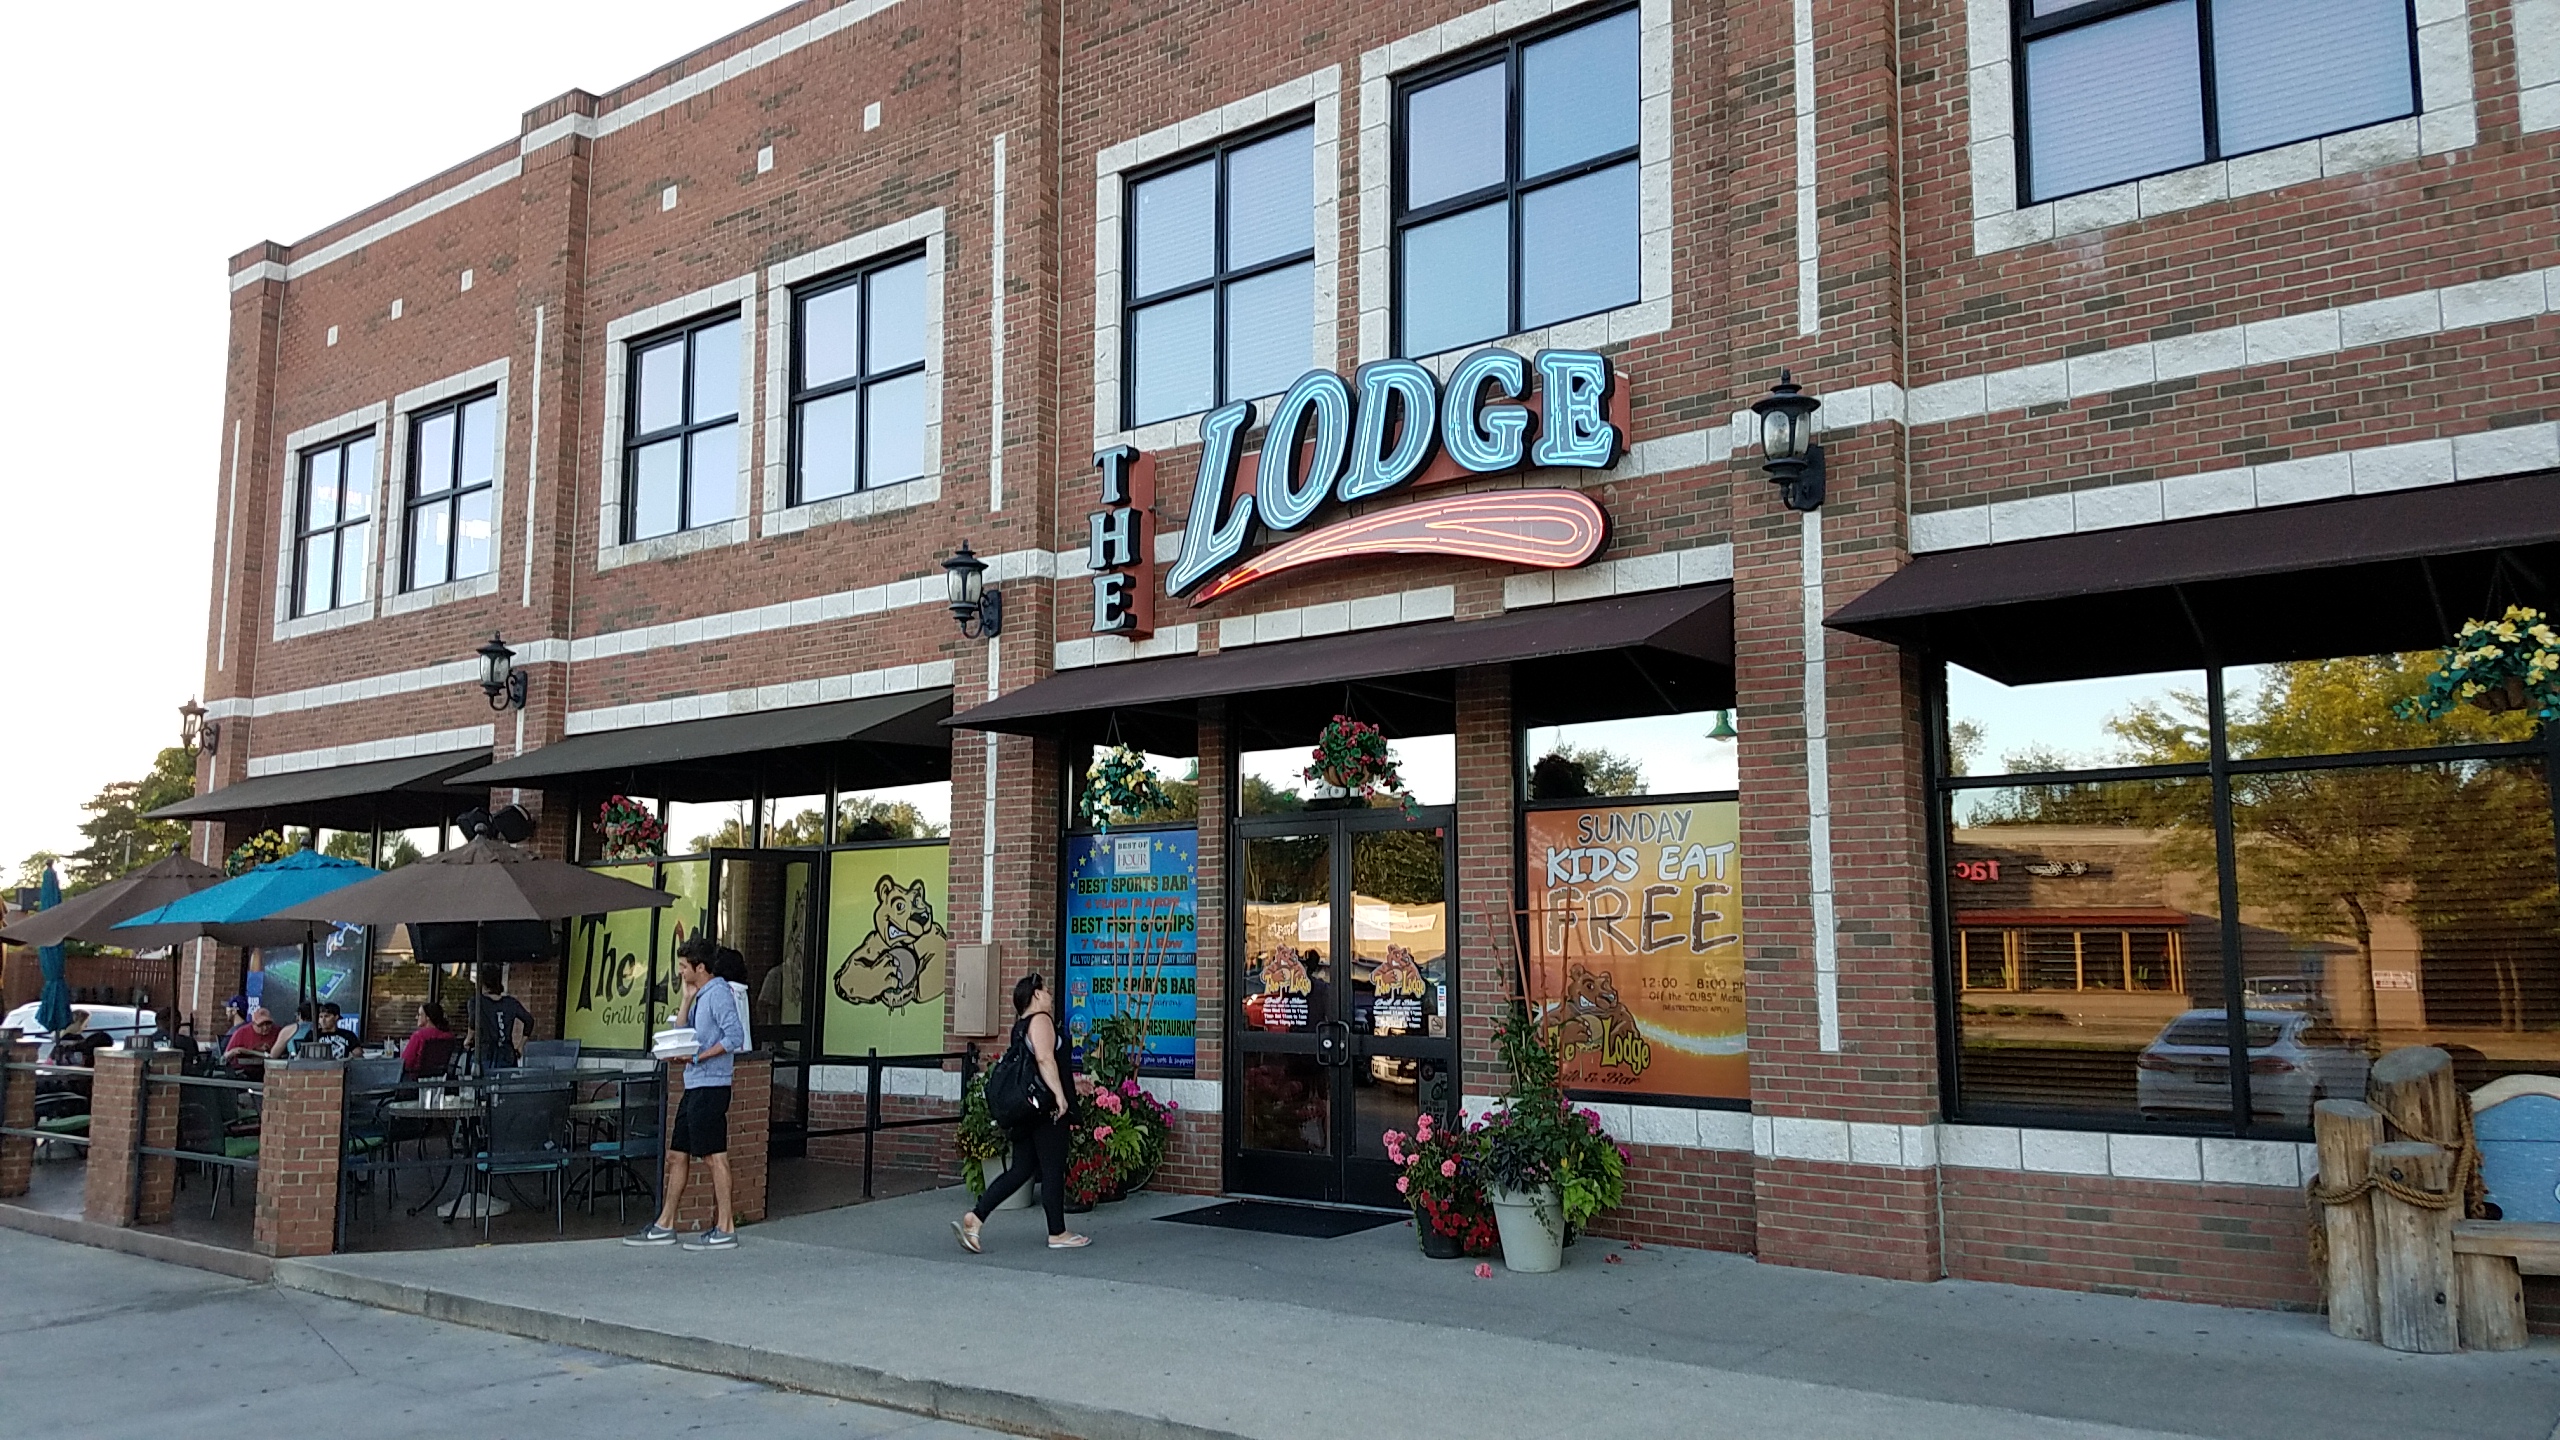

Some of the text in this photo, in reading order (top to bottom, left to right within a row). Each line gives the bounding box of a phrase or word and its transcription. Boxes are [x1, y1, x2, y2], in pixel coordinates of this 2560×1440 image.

[1165, 347, 1622, 598] LODGE
[1088, 445, 1141, 636] THE
[1577, 809, 1693, 845] SUNDAY
[1118, 841, 1148, 850] BEST OF
[1118, 853, 1147, 867] HOUR
[1546, 842, 1736, 888] KIDS EAT
[1078, 875, 1189, 894] BEST SPORTS BAR
[1085, 898, 1091, 909] 4
[1094, 897, 1128, 908] YEARS
[1154, 895, 1180, 908] ROW
[1071, 916, 1104, 934] BEST
[1107, 915, 1136, 933] FSH
[1140, 915, 1150, 933] &
[1547, 882, 1739, 955] FREE
[1081, 938, 1088, 949] 7
[1091, 938, 1125, 949] Years
[575, 911, 636, 1012] The
[1071, 955, 1080, 964] ALL
[1081, 955, 1091, 964] YOU
[1092, 977, 1121, 994] BEST
[1170, 977, 1195, 994] BAR
[1641, 977, 1677, 988] 12:00
[1697, 978, 1726, 989] 8:00
[1649, 991, 1664, 1001] Off
[1668, 992, 1682, 1001] the
[1720, 993, 1743, 1003] Menu
[602, 1006, 635, 1026] Grill
[637, 1006, 667, 1025] ad
[1149, 1019, 1196, 1037] RESTAURANT
[1600, 1014, 1651, 1076] Lodge
[1174, 1057, 1195, 1067] support
[1584, 1072, 1598, 1083] &
[1602, 1072, 1640, 1085] Bar
